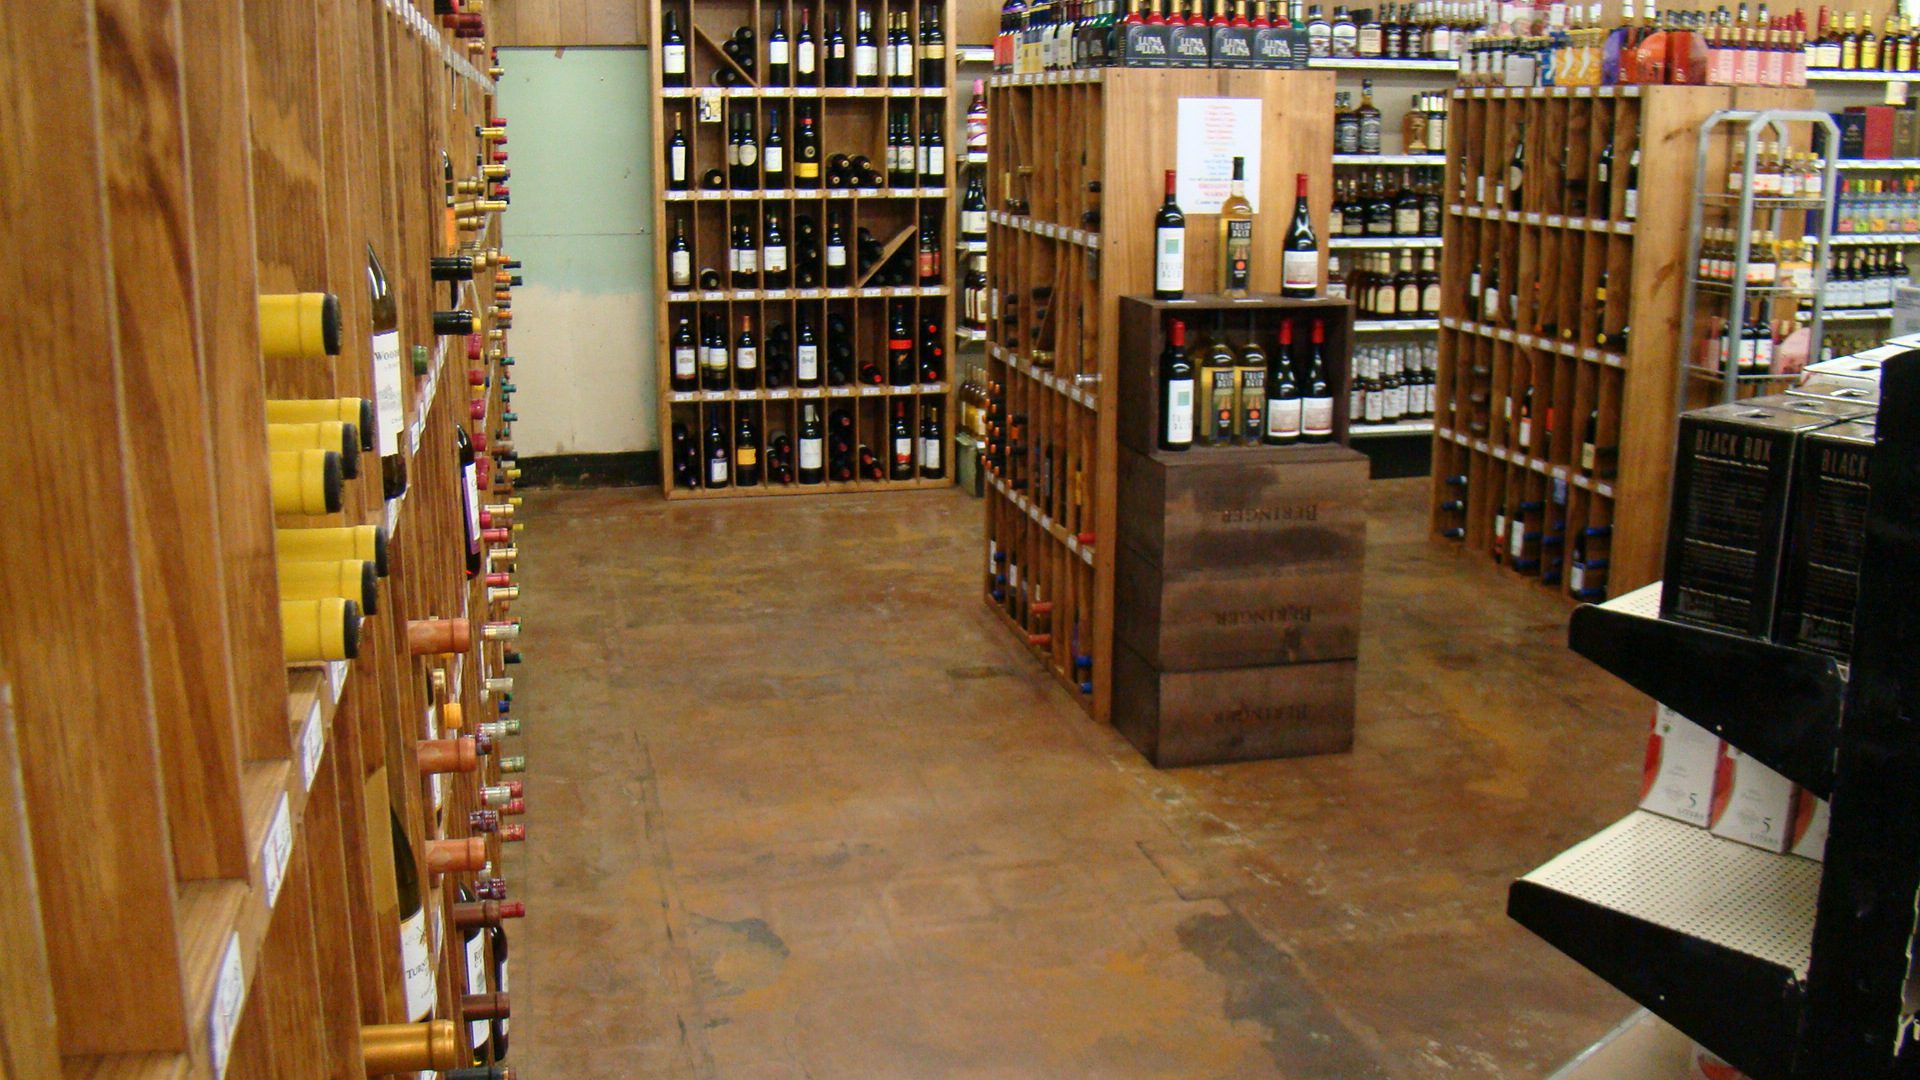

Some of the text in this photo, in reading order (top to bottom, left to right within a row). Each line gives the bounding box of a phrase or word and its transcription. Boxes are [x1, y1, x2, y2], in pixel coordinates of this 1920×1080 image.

[1695, 430, 1773, 462] BLACK BOX
[1822, 449, 1868, 480] BLACK
[1688, 791, 1698, 808] 5
[1762, 816, 1772, 833] 5
